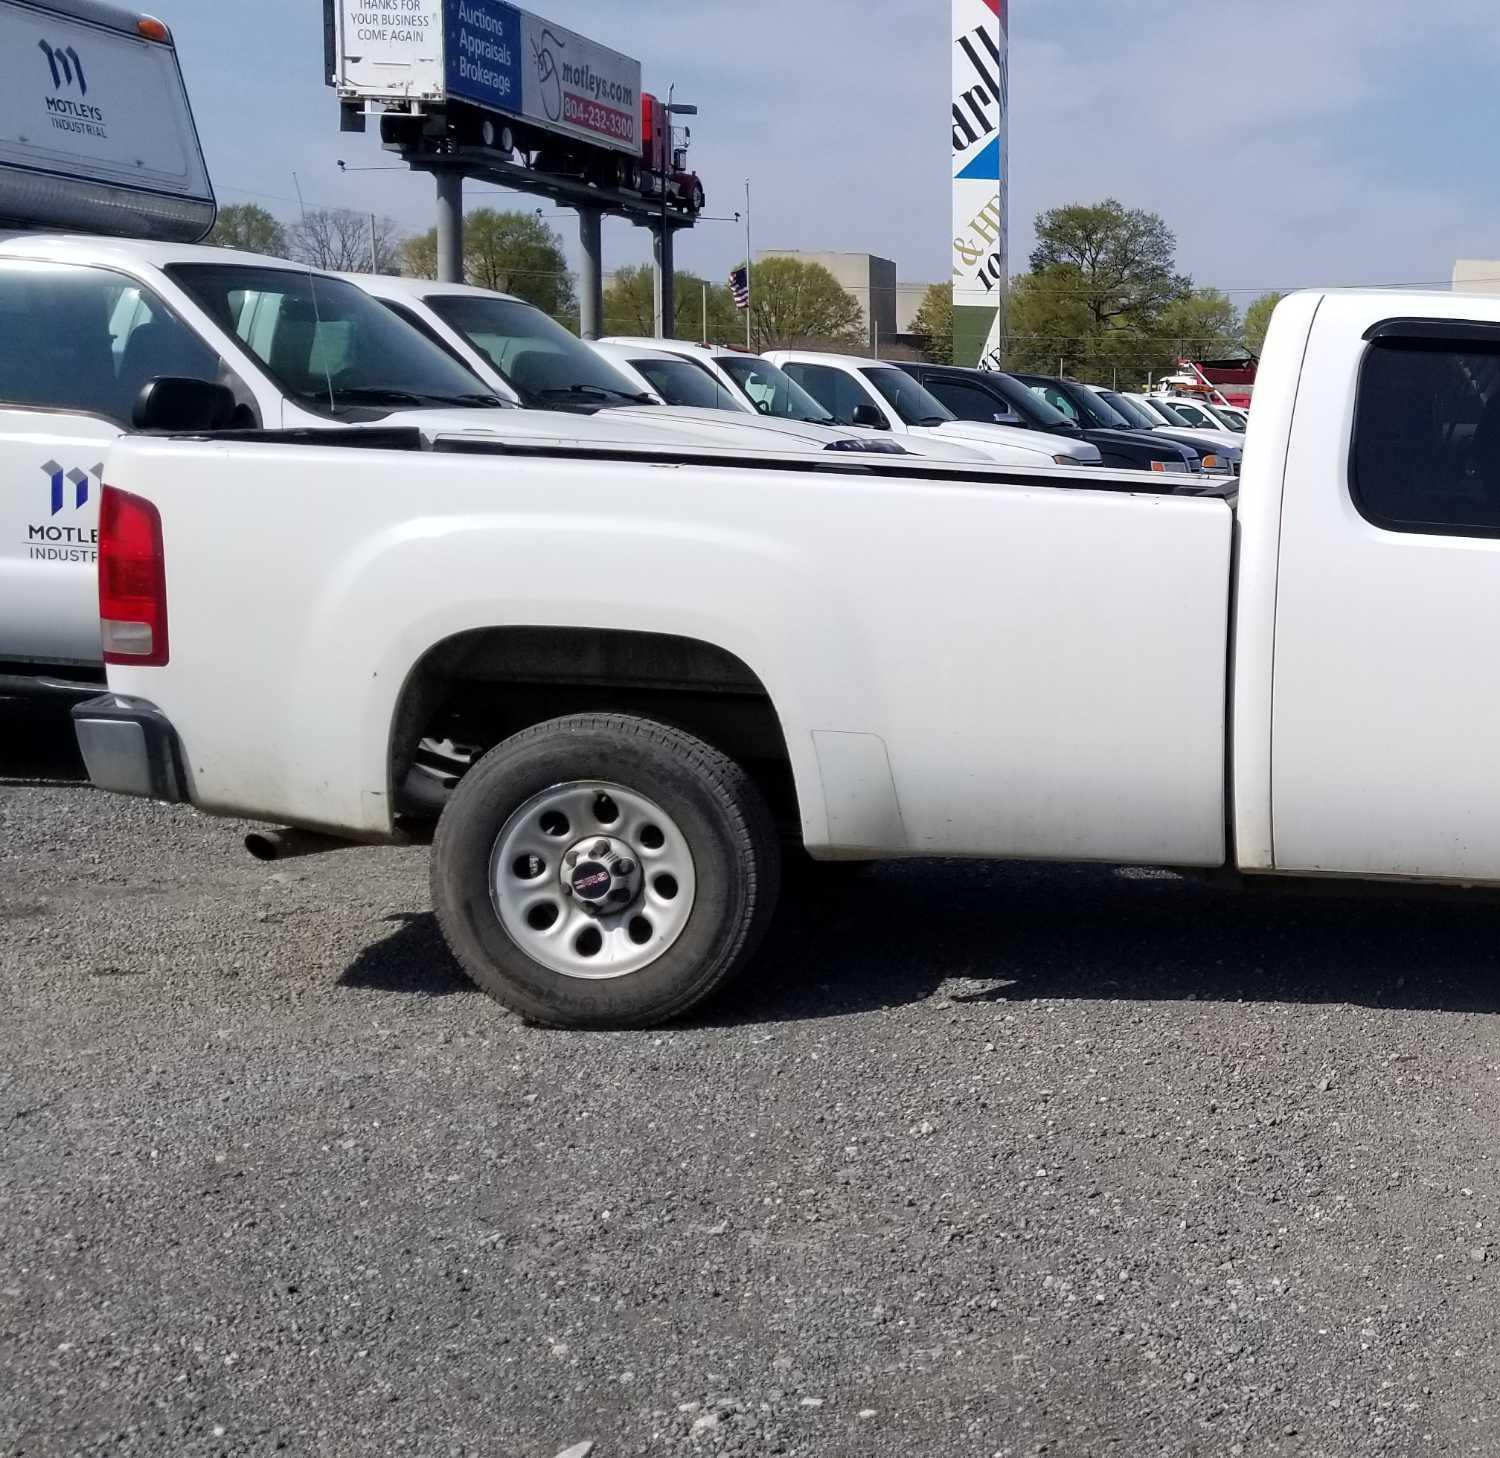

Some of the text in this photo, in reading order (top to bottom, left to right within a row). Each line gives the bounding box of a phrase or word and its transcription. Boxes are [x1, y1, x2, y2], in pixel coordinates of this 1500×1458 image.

[351, 13, 429, 27] YOUR BUSINESS
[359, 0, 421, 11] THANKS FOR
[458, 1, 503, 36] Auctions
[357, 29, 424, 42] COME AGAIN
[459, 27, 512, 67] Appraisals
[459, 55, 512, 96] Brokerage
[562, 62, 633, 106] motleys.com
[45, 96, 103, 121] MOTLEYS
[564, 97, 633, 139] 804-232-3300
[51, 117, 108, 139] INDUSTRIAL
